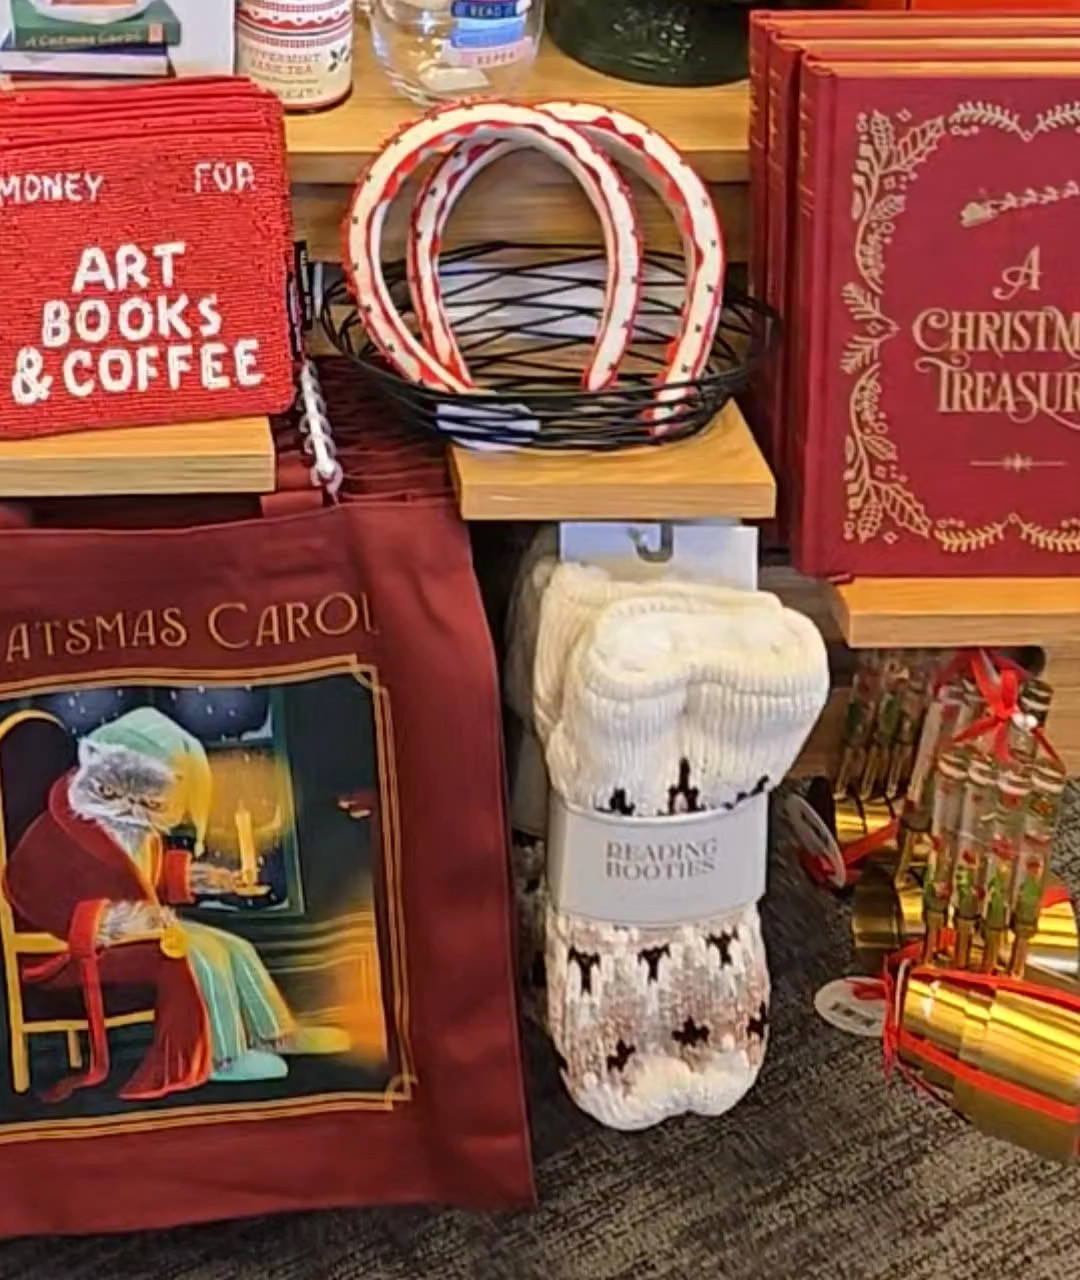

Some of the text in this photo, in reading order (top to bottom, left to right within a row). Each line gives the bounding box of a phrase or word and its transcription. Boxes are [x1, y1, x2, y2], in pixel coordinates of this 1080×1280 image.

[470, 3, 502, 18] READ
[193, 160, 257, 193] FOR
[72, 241, 187, 293] ART
[992, 244, 1043, 301] A
[41, 293, 223, 348] BOOKS
[207, 591, 381, 650] CAROL
[606, 836, 718, 862] READING
[606, 859, 716, 881] BOOTIES
